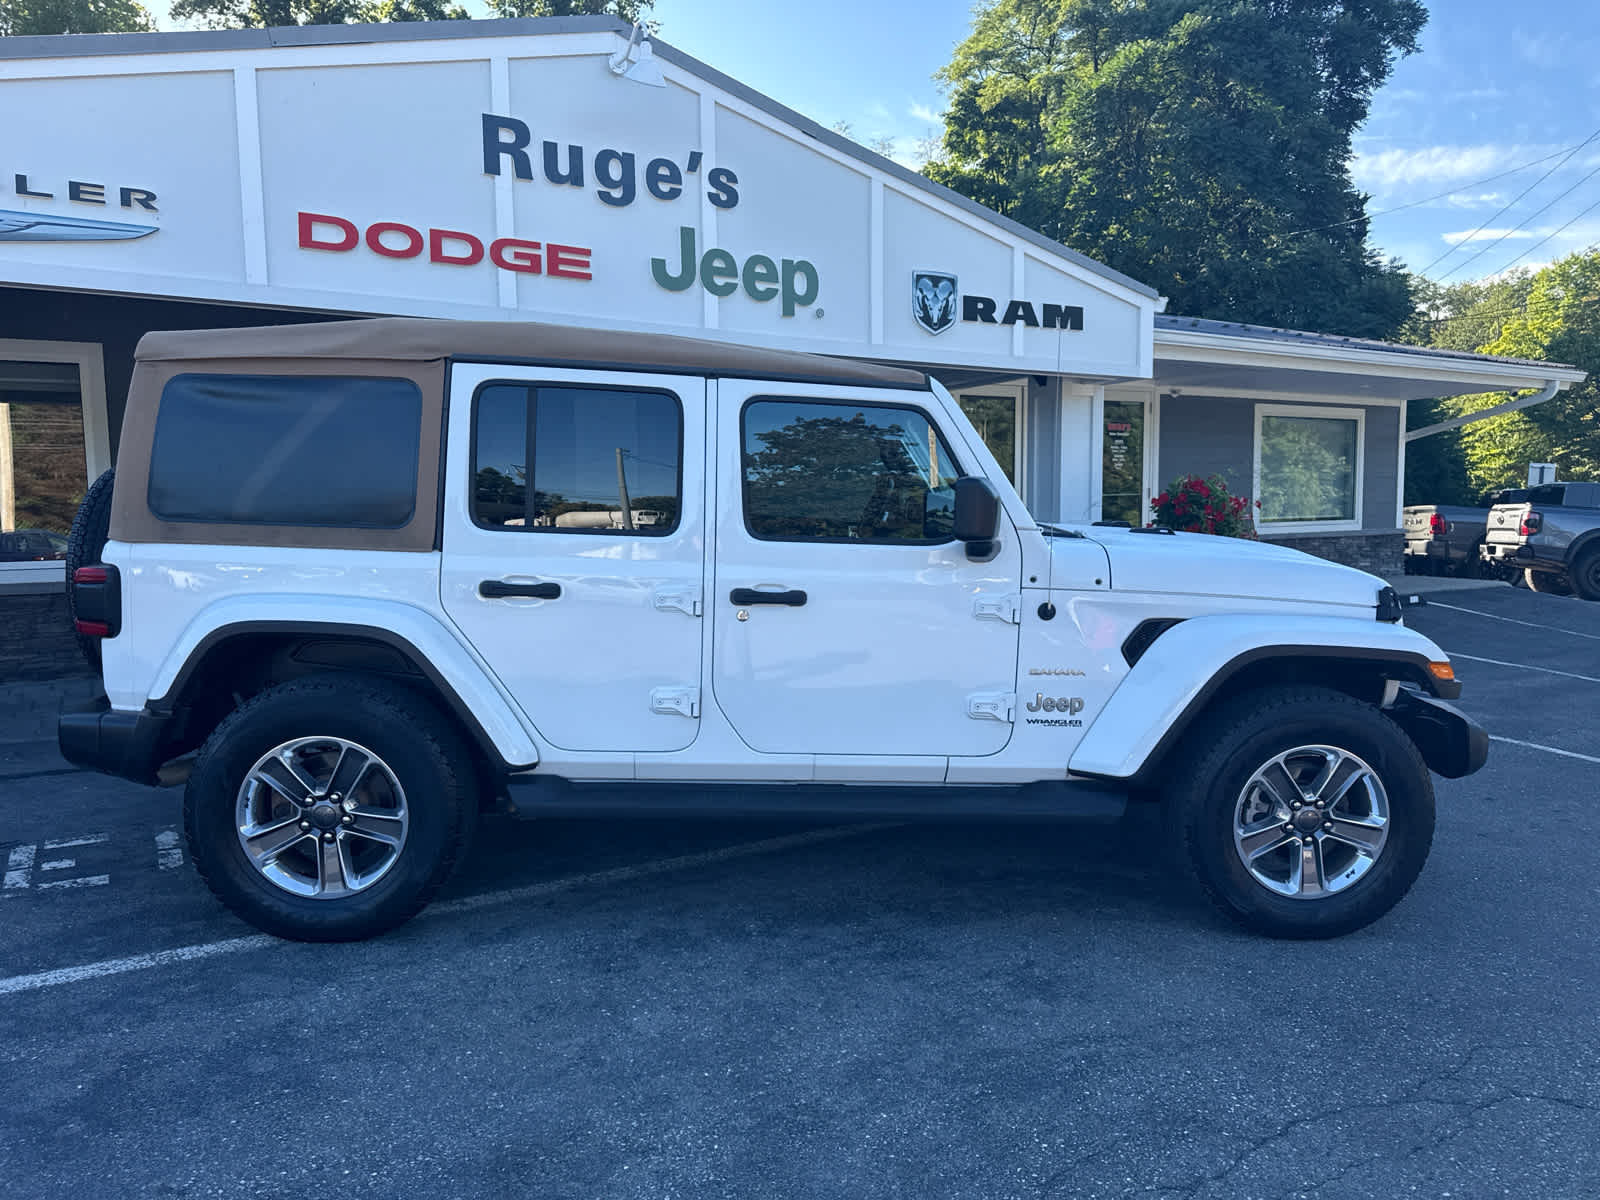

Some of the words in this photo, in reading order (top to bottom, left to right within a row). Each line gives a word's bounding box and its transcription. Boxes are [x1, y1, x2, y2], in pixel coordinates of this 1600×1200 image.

[482, 112, 739, 209] Ruge's
[298, 211, 592, 281] DODGE
[962, 295, 1084, 330] RAM
[1026, 692, 1085, 716] Jeep
